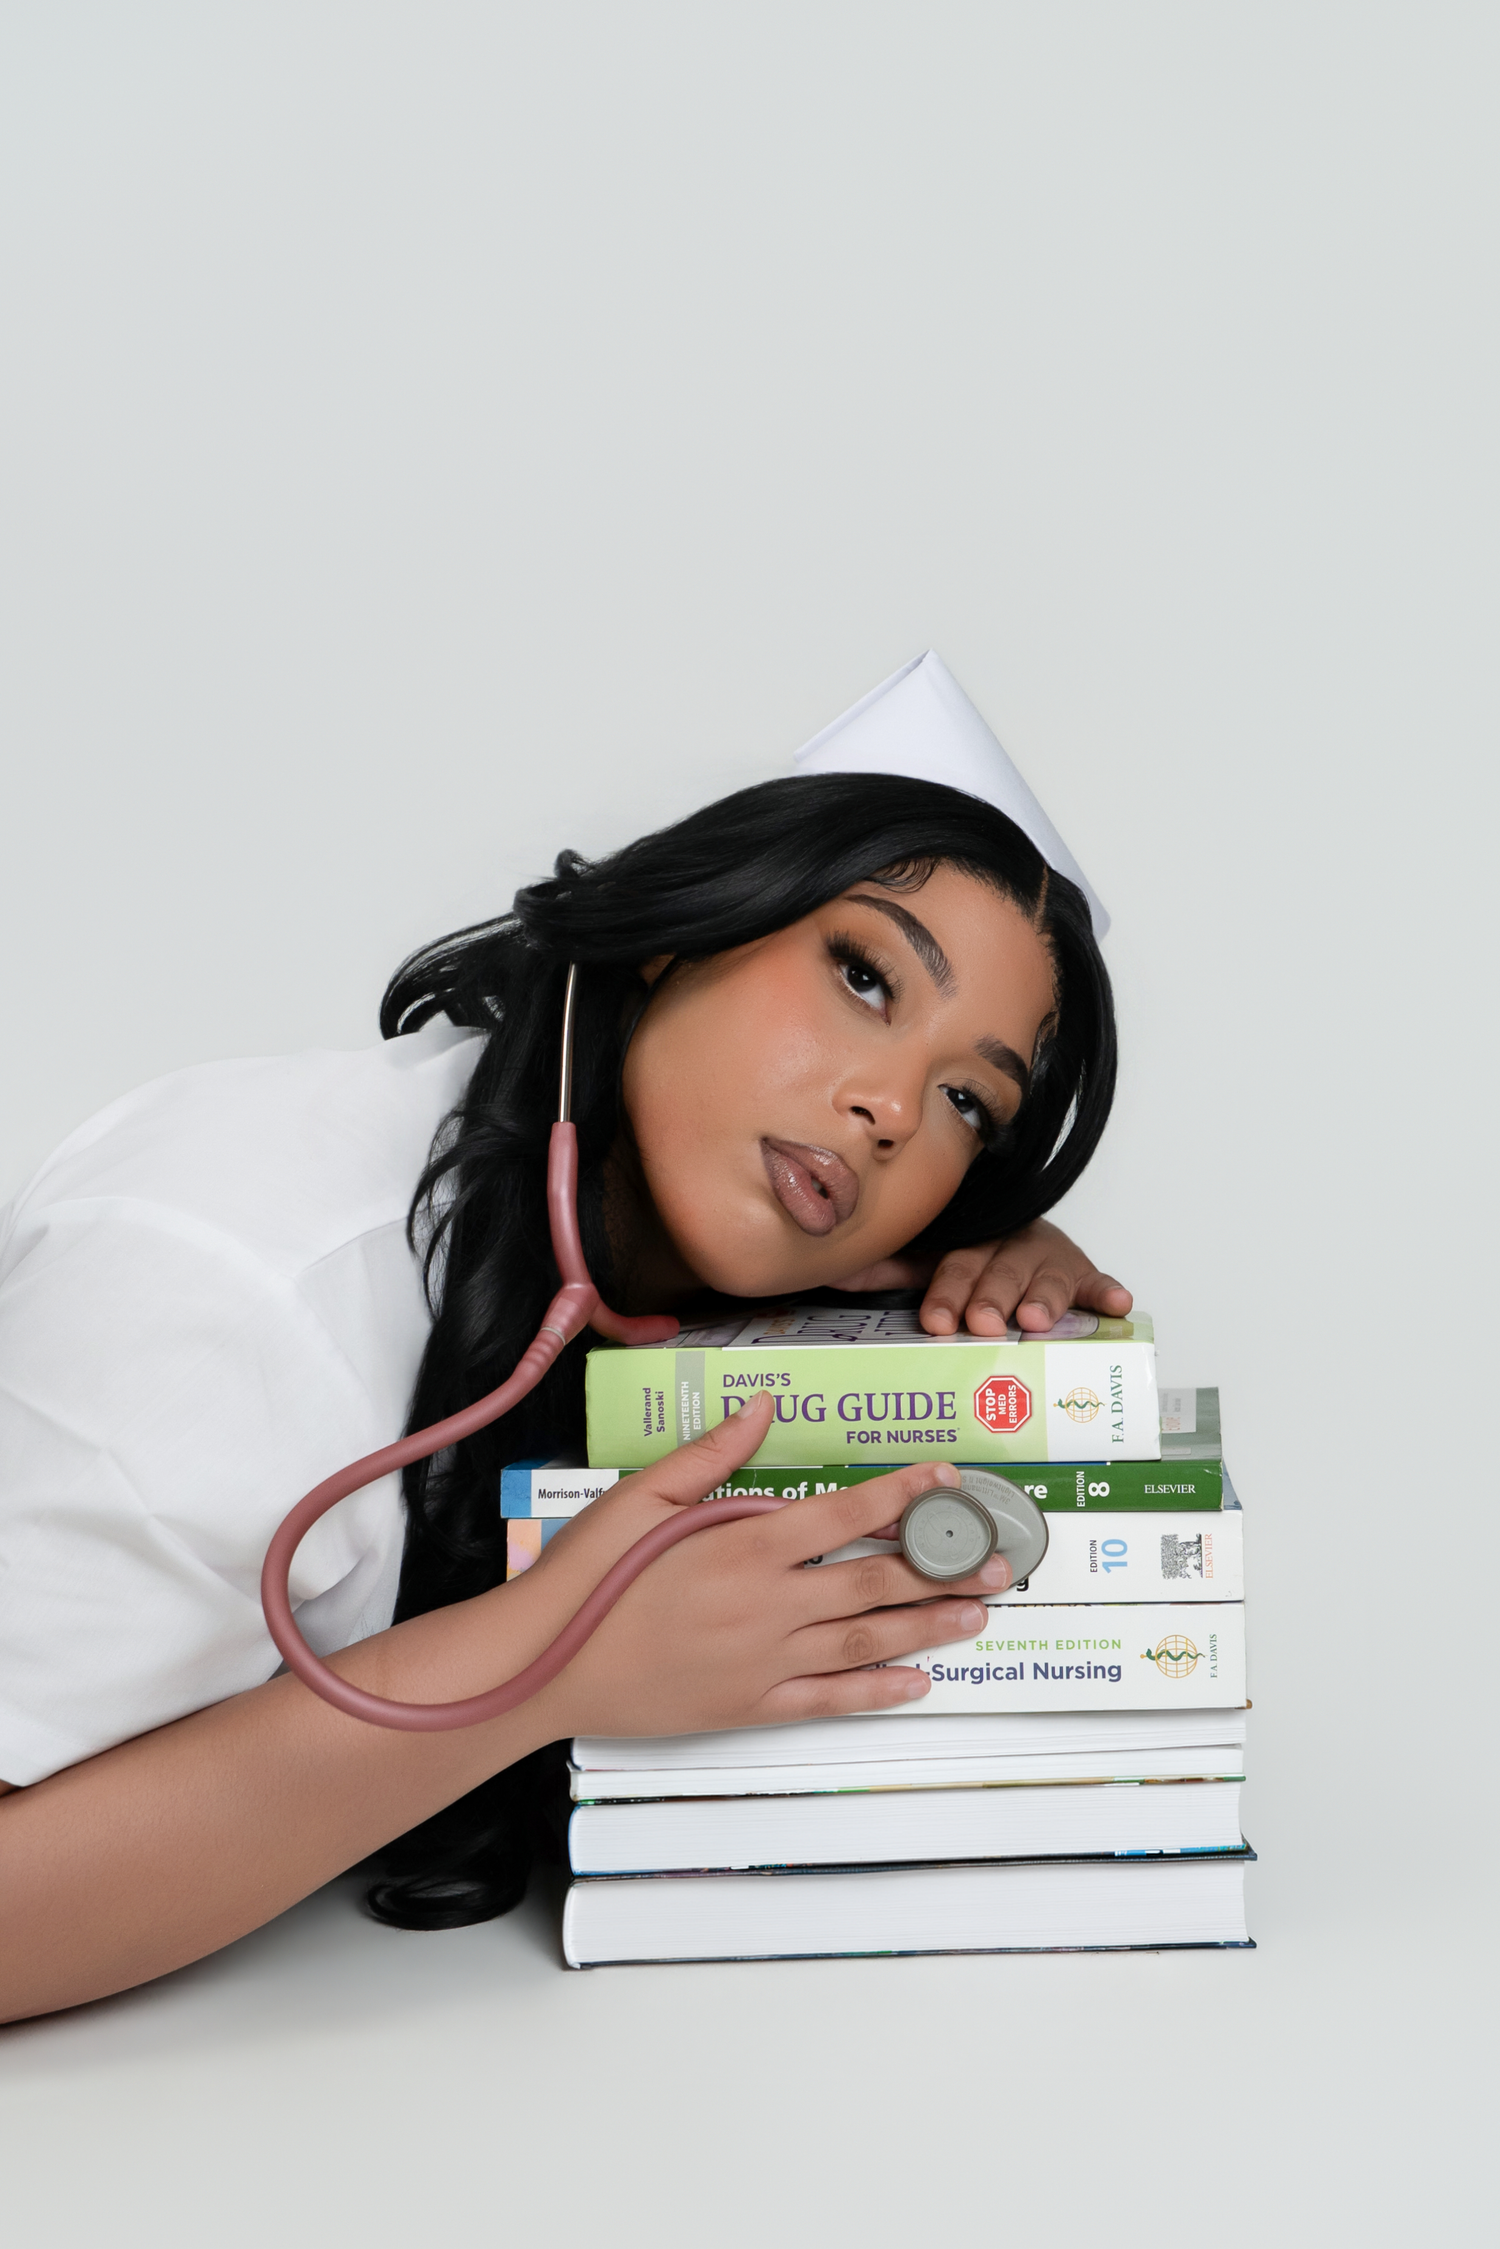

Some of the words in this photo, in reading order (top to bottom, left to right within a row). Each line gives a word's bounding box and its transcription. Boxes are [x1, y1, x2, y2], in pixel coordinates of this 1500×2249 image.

[723, 1373, 791, 1387] DAVIS’S
[1109, 1365, 1124, 1414] DAVIS
[642, 1387, 652, 1437] Vallerand
[655, 1391, 665, 1433] Sanoski
[681, 1381, 691, 1440] NINETEENTH
[692, 1392, 701, 1430] EDITION
[721, 1393, 827, 1423] DUG
[837, 1391, 957, 1422] GUIDE
[985, 1388, 997, 1421] STOP
[998, 1393, 1007, 1415] MED
[1008, 1385, 1017, 1424] ERRORS
[846, 1430, 882, 1444] FOR
[887, 1429, 958, 1444] NURSES
[1111, 1417, 1124, 1443] F.A.
[538, 1487, 606, 1499] Morrison-Valf
[702, 1482, 775, 1501] ations
[782, 1481, 808, 1500] of
[1024, 1484, 1048, 1499] re
[1076, 1471, 1085, 1507] EDITION
[1088, 1481, 1110, 1497] 8
[1144, 1484, 1196, 1494] ELSEVIER
[1089, 1540, 1098, 1573] EDITION
[1101, 1539, 1128, 1574] 10
[1204, 1533, 1213, 1579] ELSEVIER
[975, 1640, 1048, 1651] SEVENTH
[1055, 1639, 1122, 1650] EDITION
[1209, 1633, 1217, 1661] DAVIS
[916, 1661, 1025, 1685] -Surgical
[1033, 1661, 1122, 1683] Nursing
